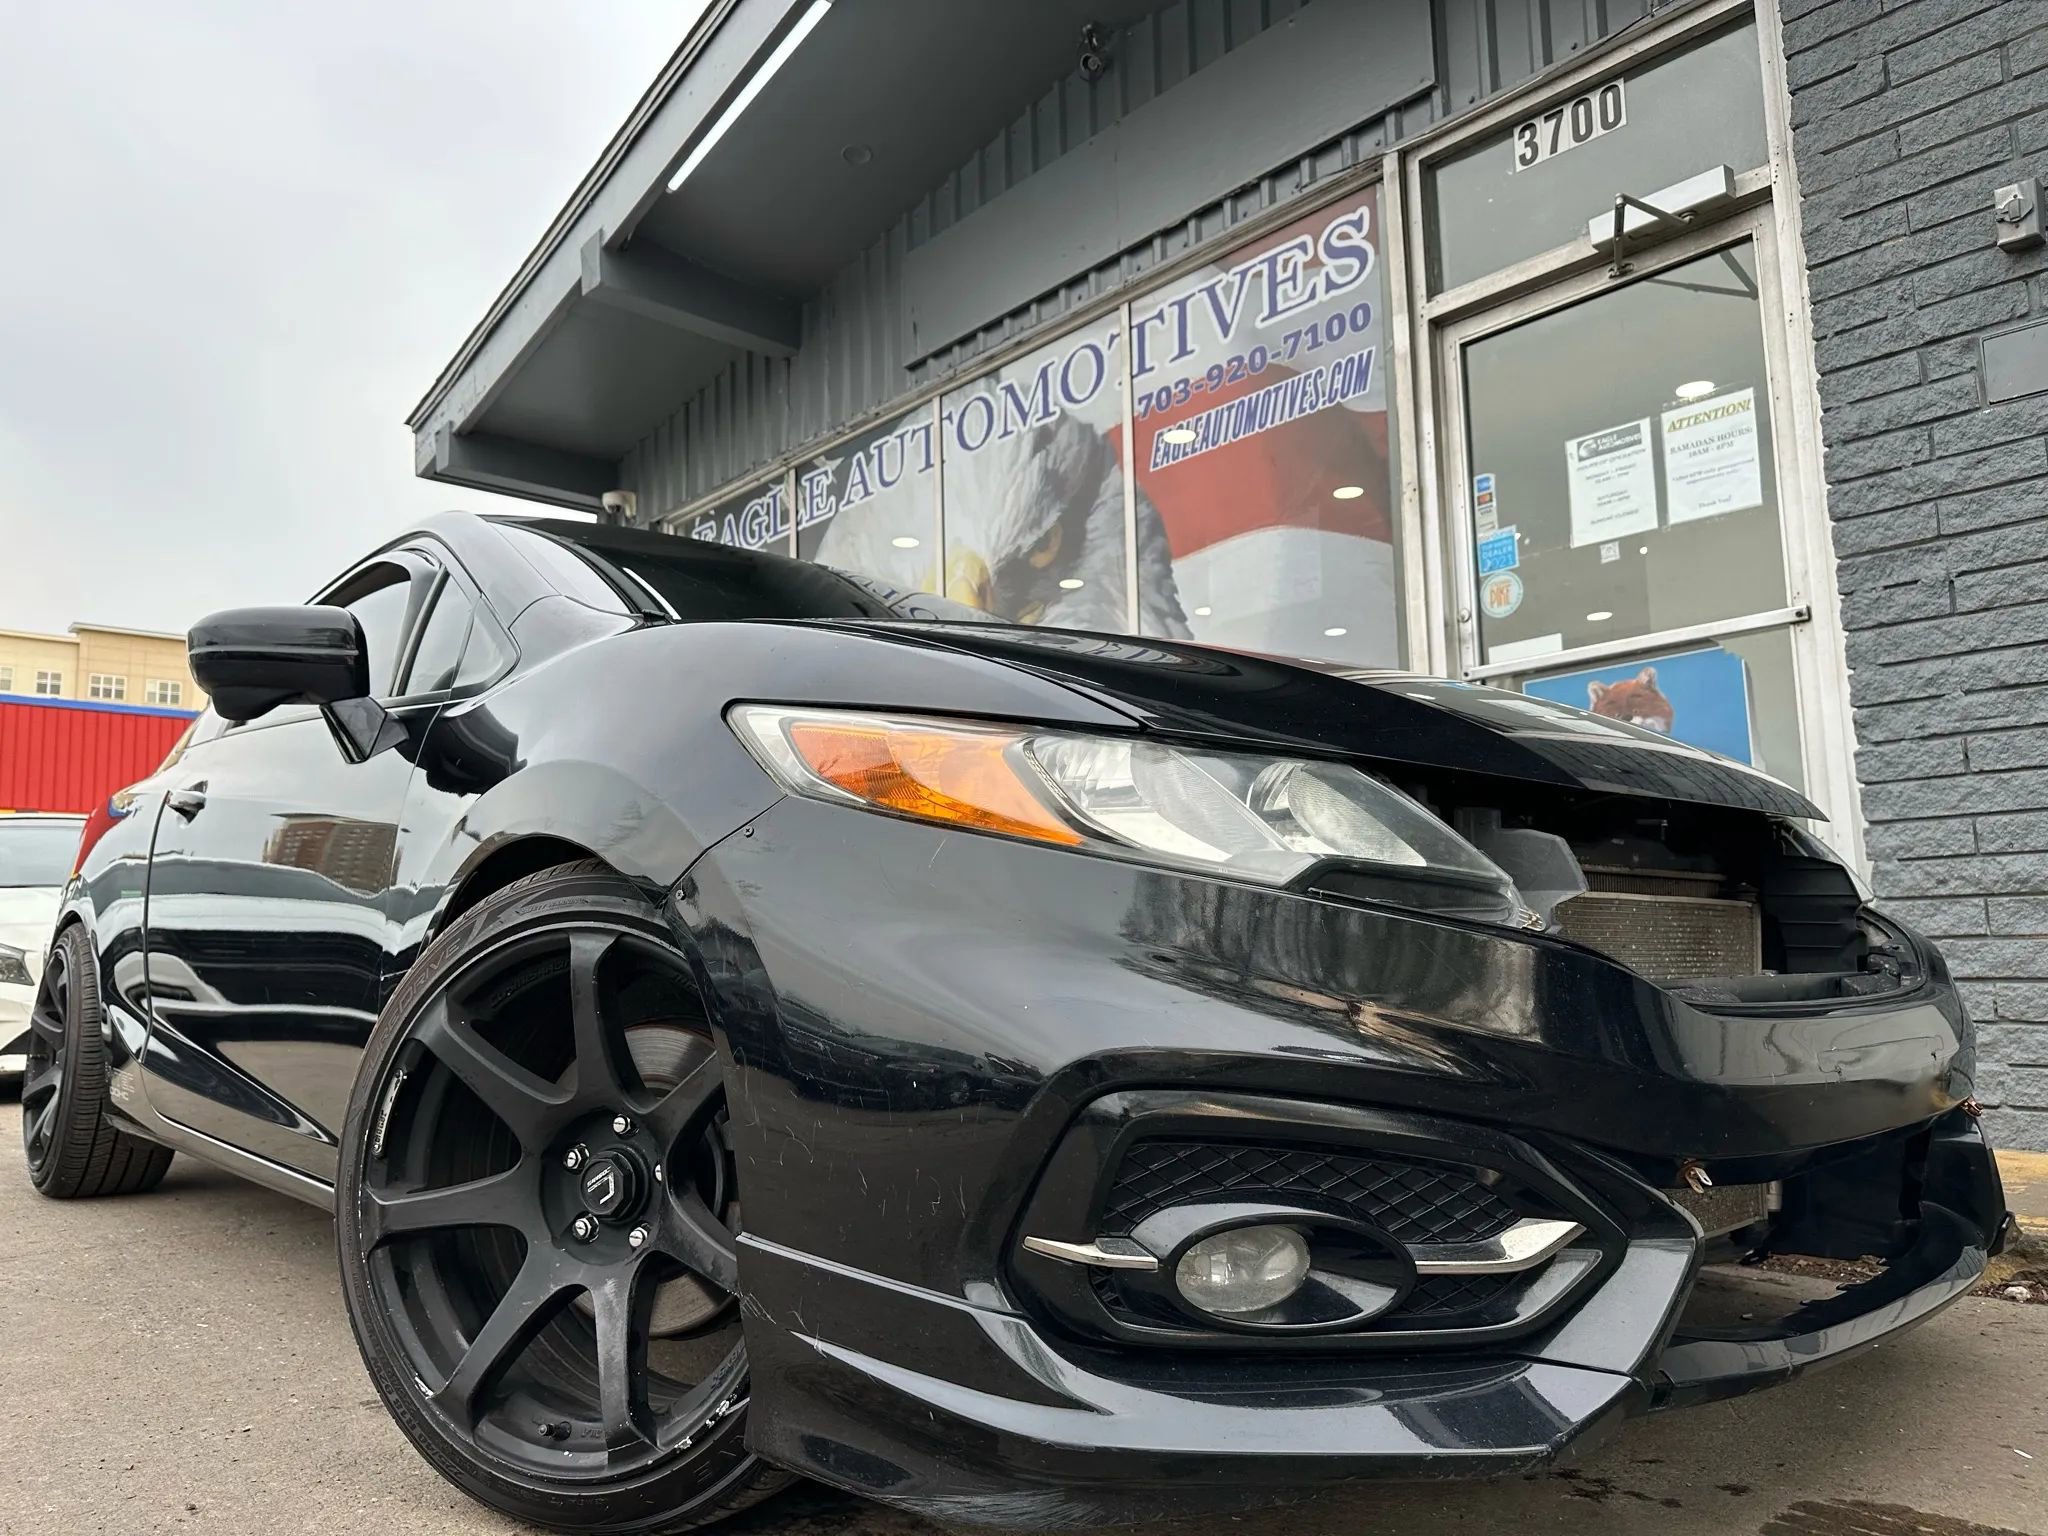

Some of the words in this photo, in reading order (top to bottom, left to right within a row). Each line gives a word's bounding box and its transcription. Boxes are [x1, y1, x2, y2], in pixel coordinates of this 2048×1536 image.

[1517, 83, 1622, 167] 3700
[840, 207, 1374, 508] AUTOMOTIVES
[1138, 302, 1371, 418] 703-920-7100
[1150, 347, 1375, 471] EAGLEAUTOMOTIVES.COM
[1667, 398, 1752, 433] ATTENTION!
[1669, 436, 1715, 455] RAMADAN
